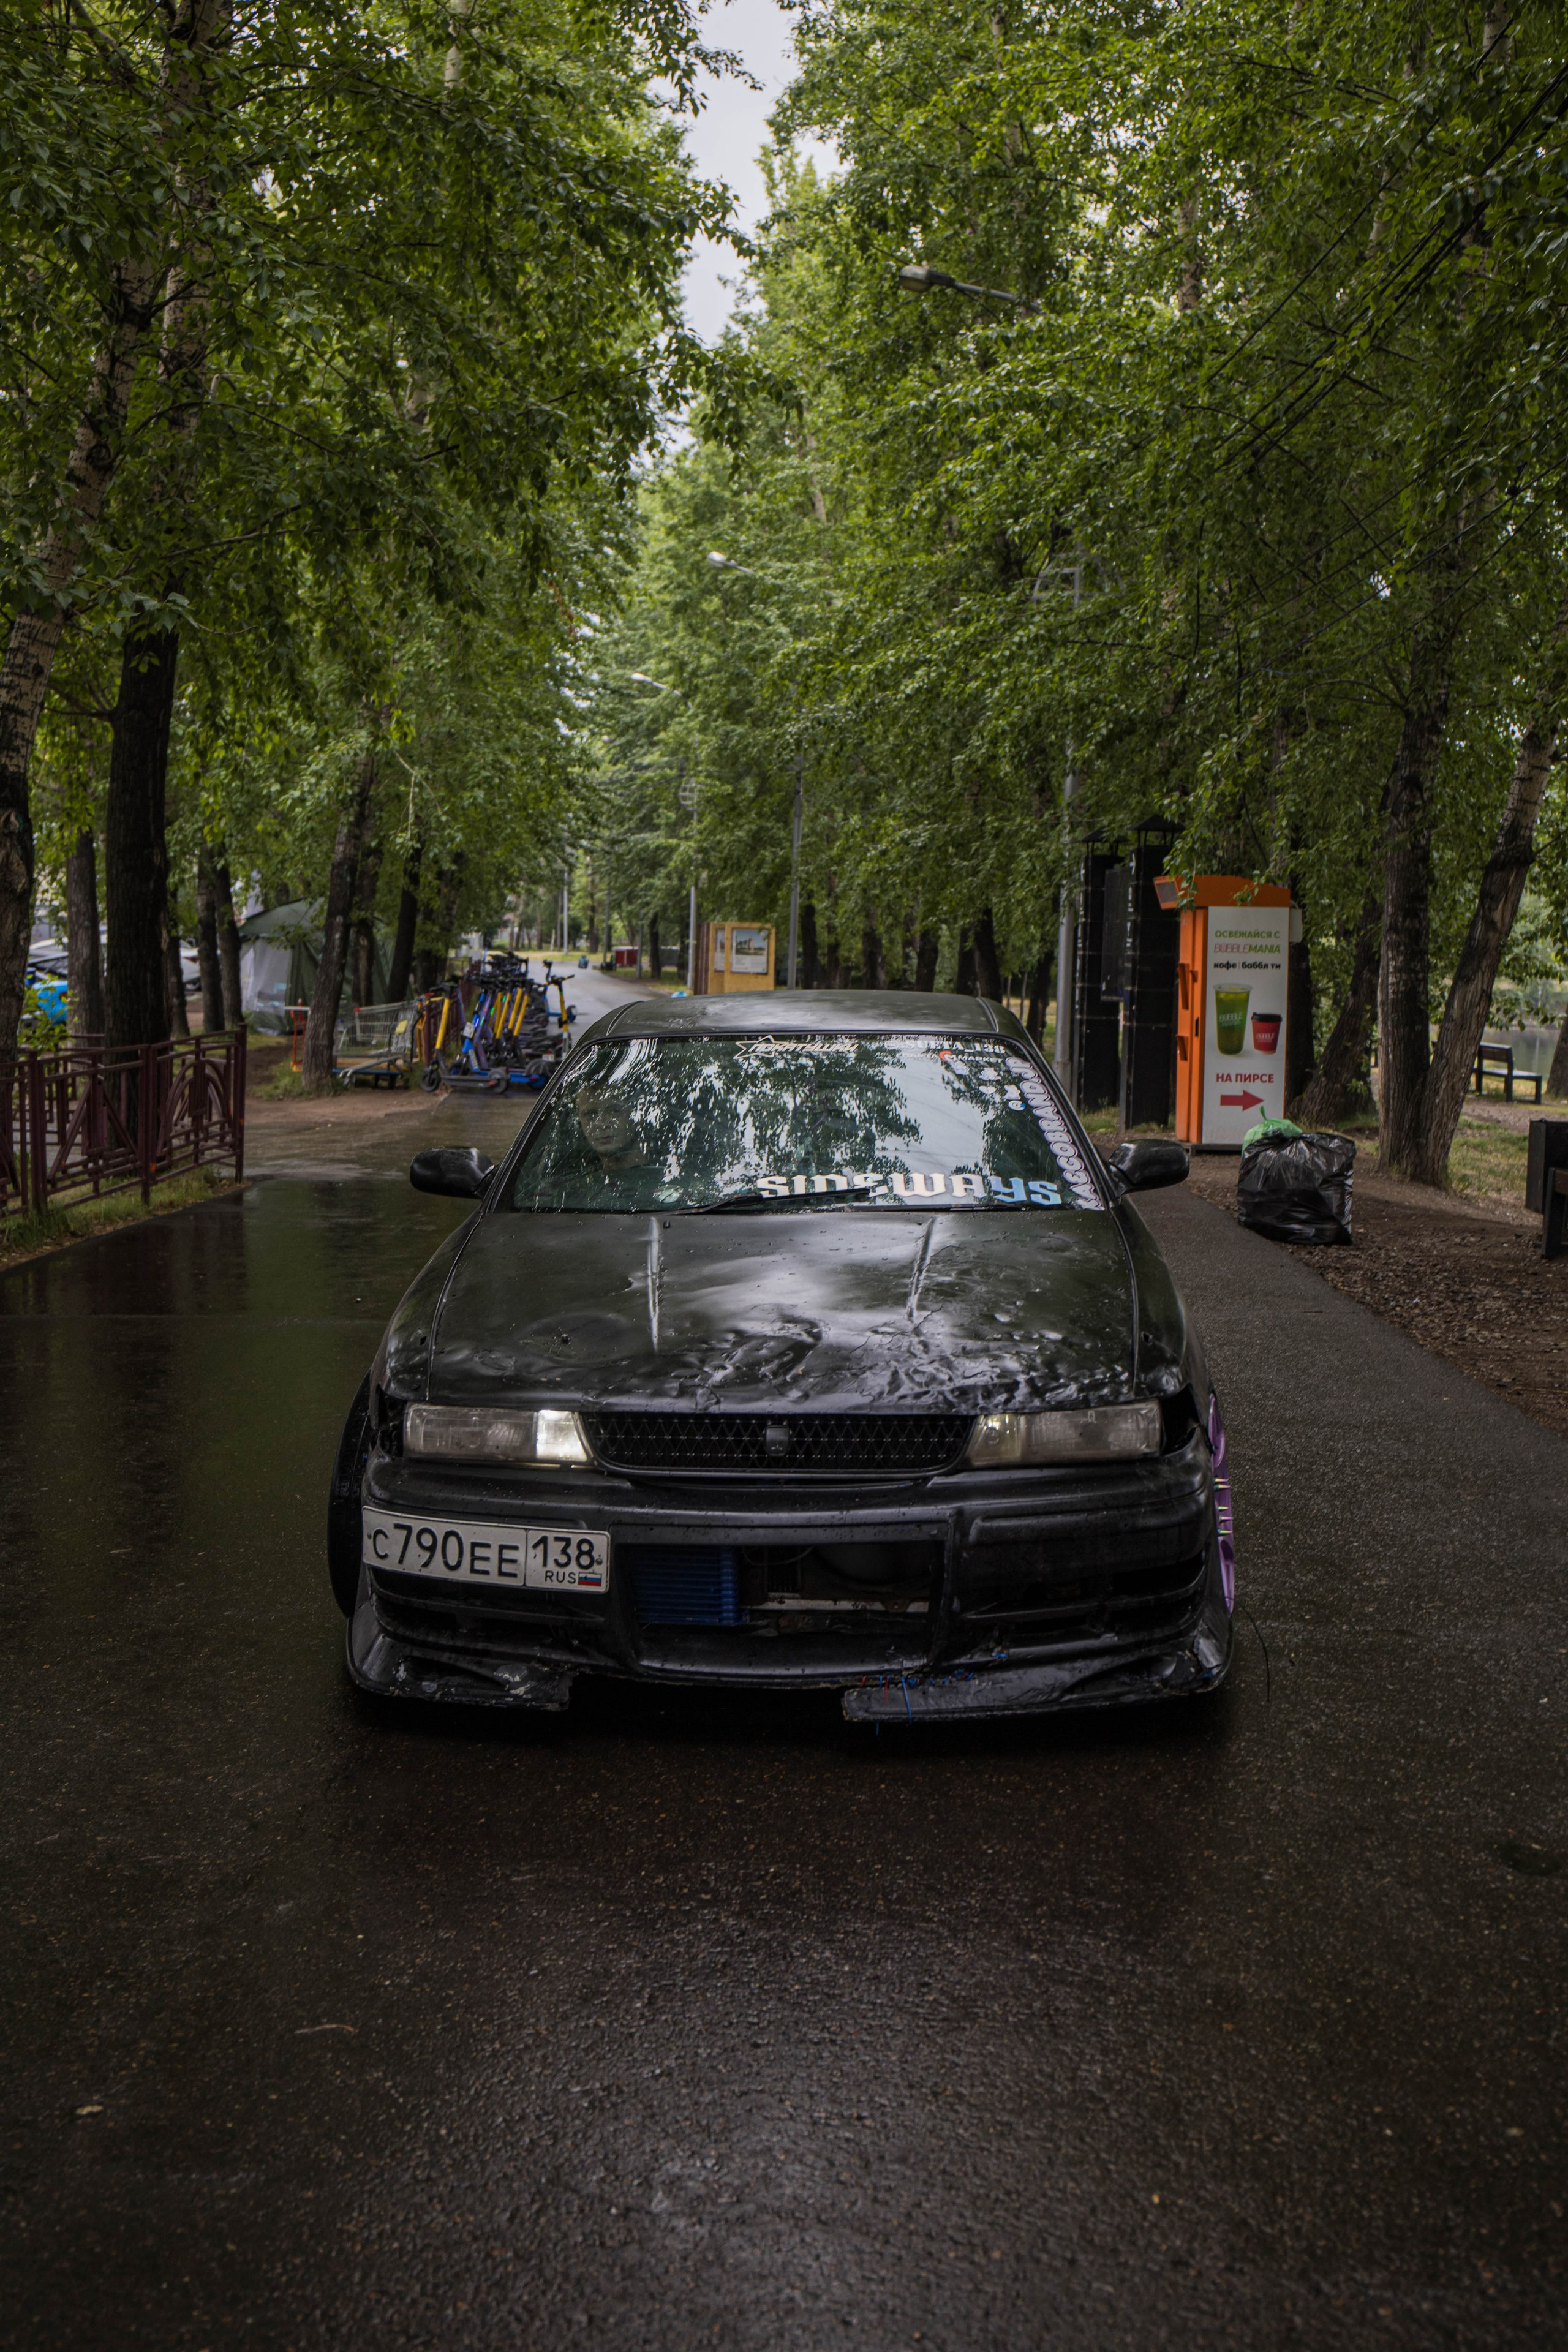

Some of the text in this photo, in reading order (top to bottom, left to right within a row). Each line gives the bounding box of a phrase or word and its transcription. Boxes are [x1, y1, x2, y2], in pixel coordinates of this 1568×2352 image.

[1215, 929, 1272, 938] ОСВЕЖАЙСЯ
[1213, 961, 1237, 970] кофе
[1242, 961, 1268, 970] баббл
[748, 1042, 859, 1052] ПОКАТУШКИ
[1216, 1073, 1275, 1084] НА ПИРСЕ
[532, 1535, 596, 1570] 138
[544, 1570, 577, 1585] RUS
